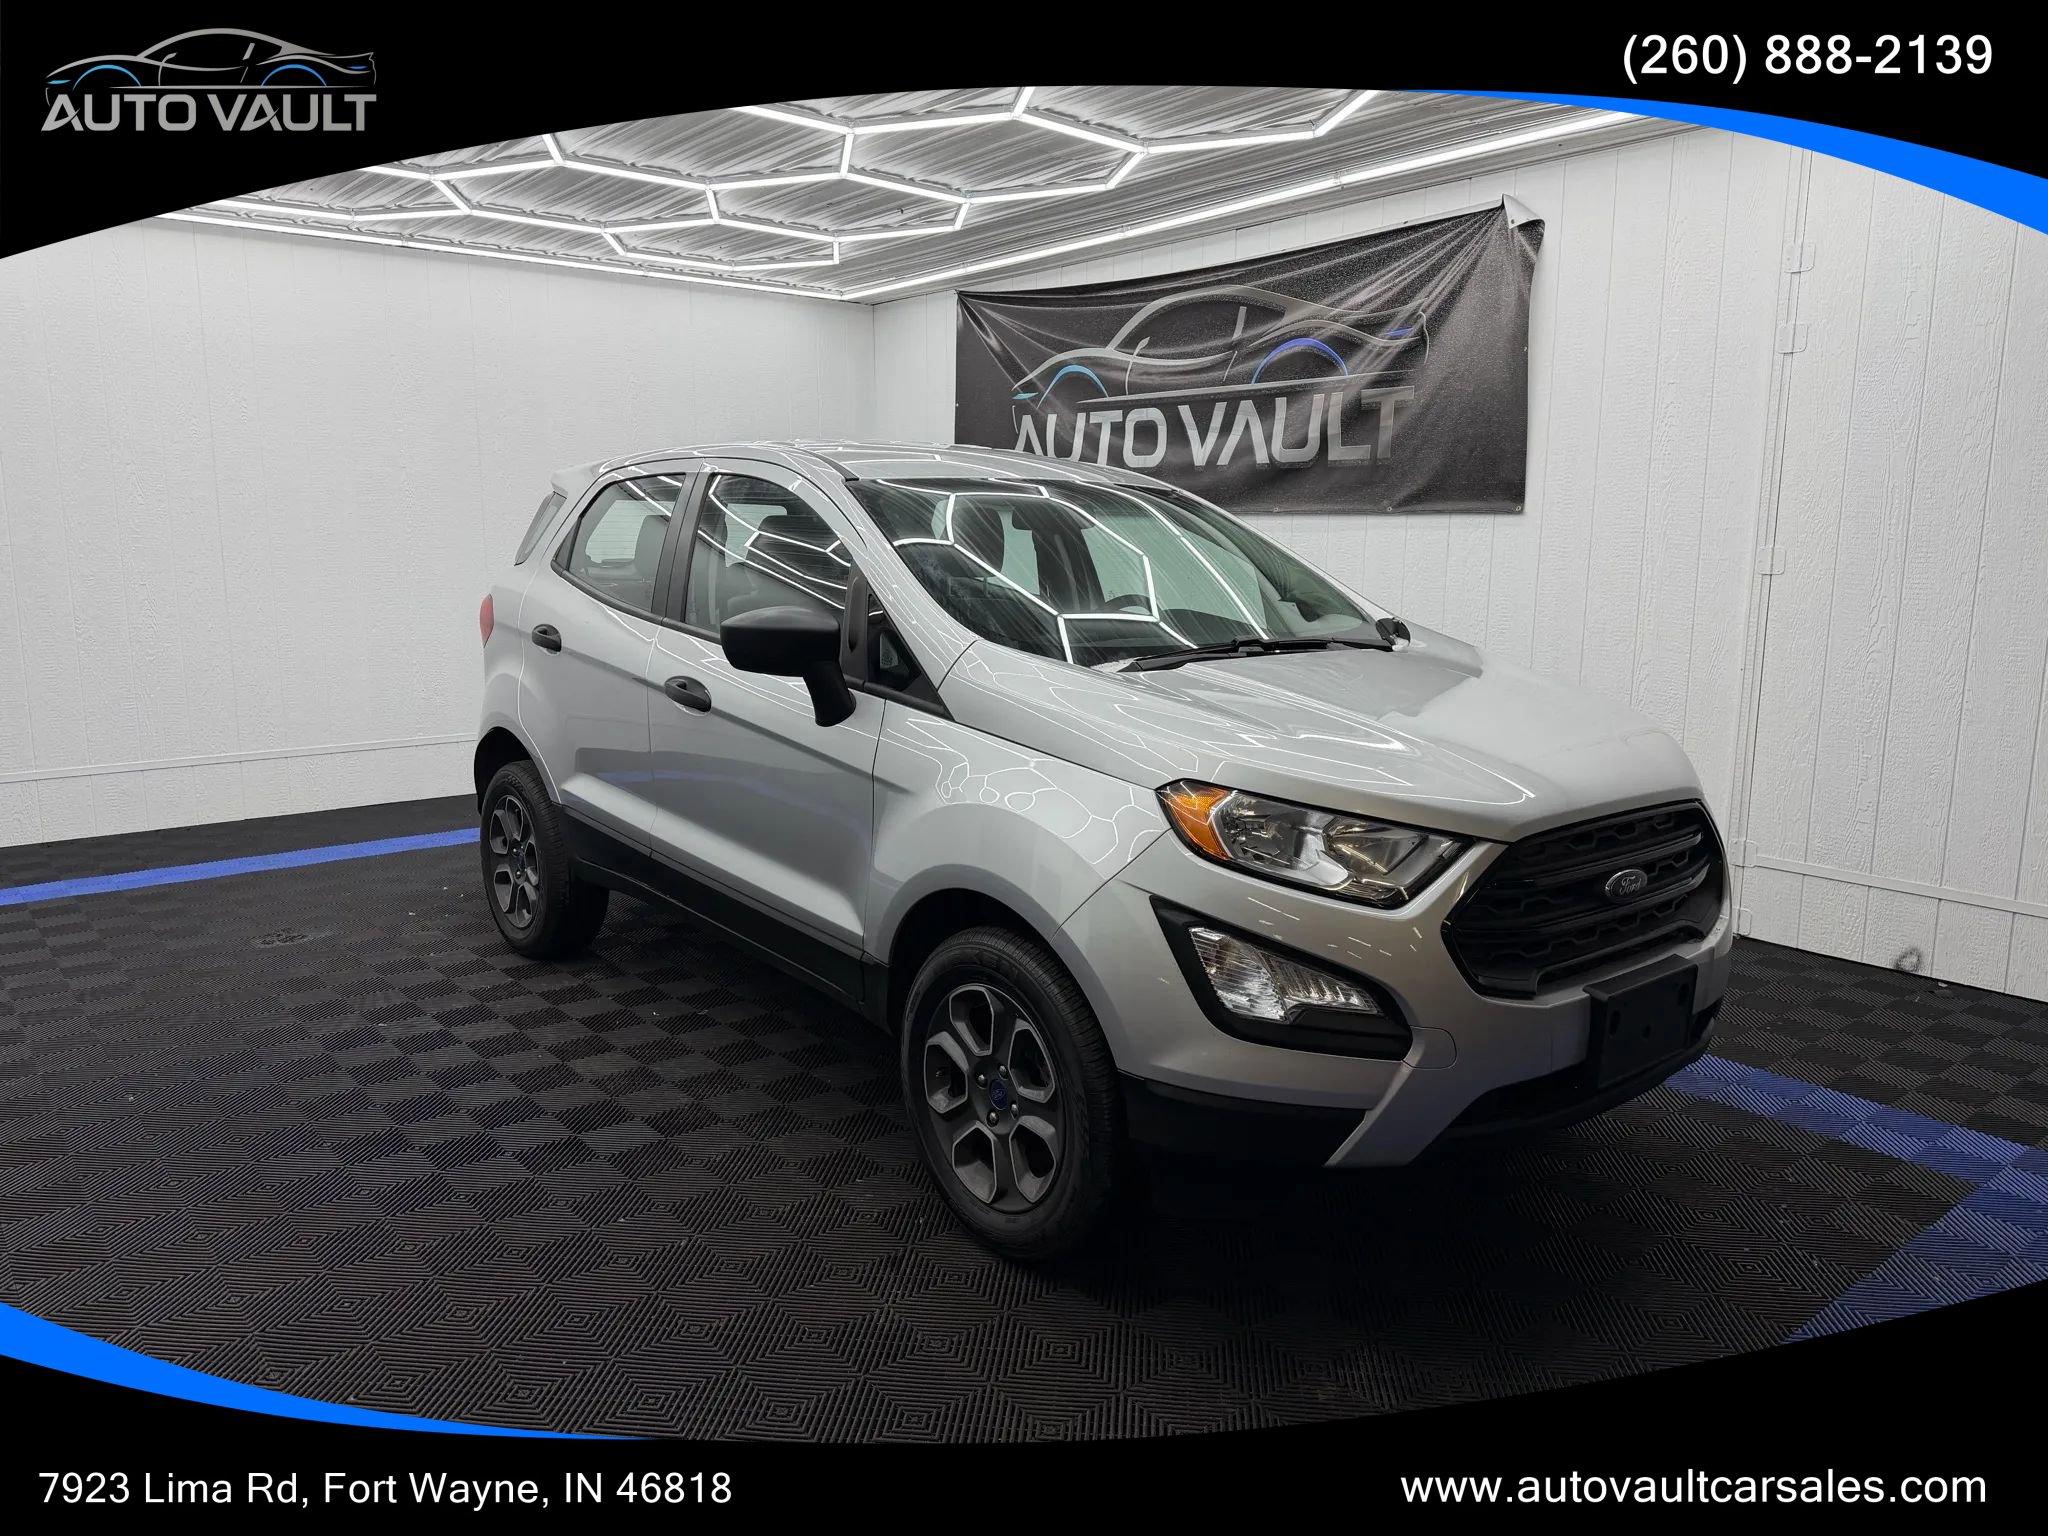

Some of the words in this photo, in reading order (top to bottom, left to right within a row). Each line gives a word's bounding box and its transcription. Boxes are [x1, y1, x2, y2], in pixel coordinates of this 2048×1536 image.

[1014, 407, 1168, 468] AUTO
[1177, 385, 1415, 467] VAULT
[1619, 875, 1642, 896] Ford
